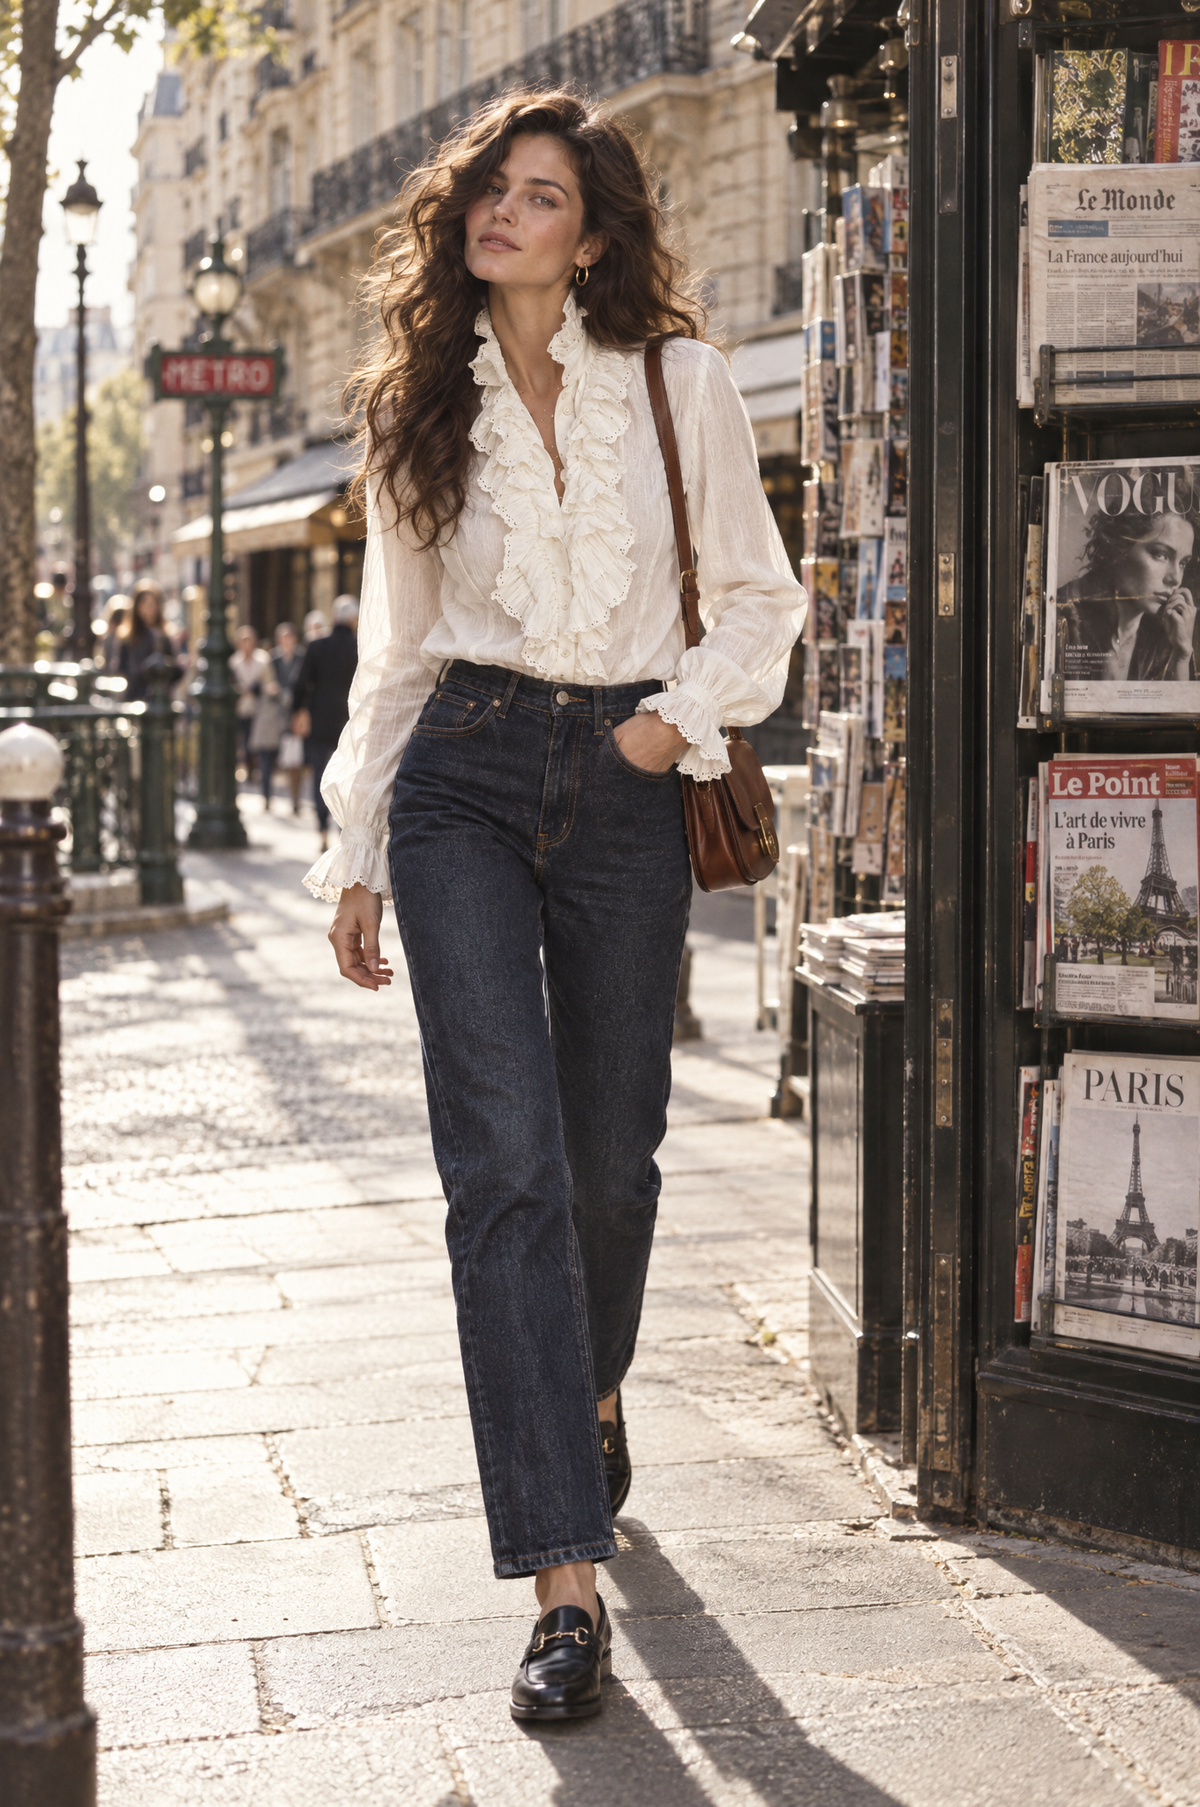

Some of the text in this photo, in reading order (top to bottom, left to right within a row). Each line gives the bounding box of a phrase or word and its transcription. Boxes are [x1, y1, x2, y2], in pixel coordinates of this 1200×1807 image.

[1075, 188, 1176, 211] Le Monde
[1048, 249, 1183, 266] La France aujourd'hui
[165, 359, 270, 392] METRO
[1071, 471, 1200, 516] VOGU
[1052, 772, 1083, 796] Le
[1087, 770, 1160, 796] Point
[1054, 811, 1087, 829] L'art
[1090, 811, 1107, 828] de
[1110, 811, 1146, 828] vivre
[1066, 832, 1115, 849] à Paris
[1083, 1068, 1185, 1108] PARIS
